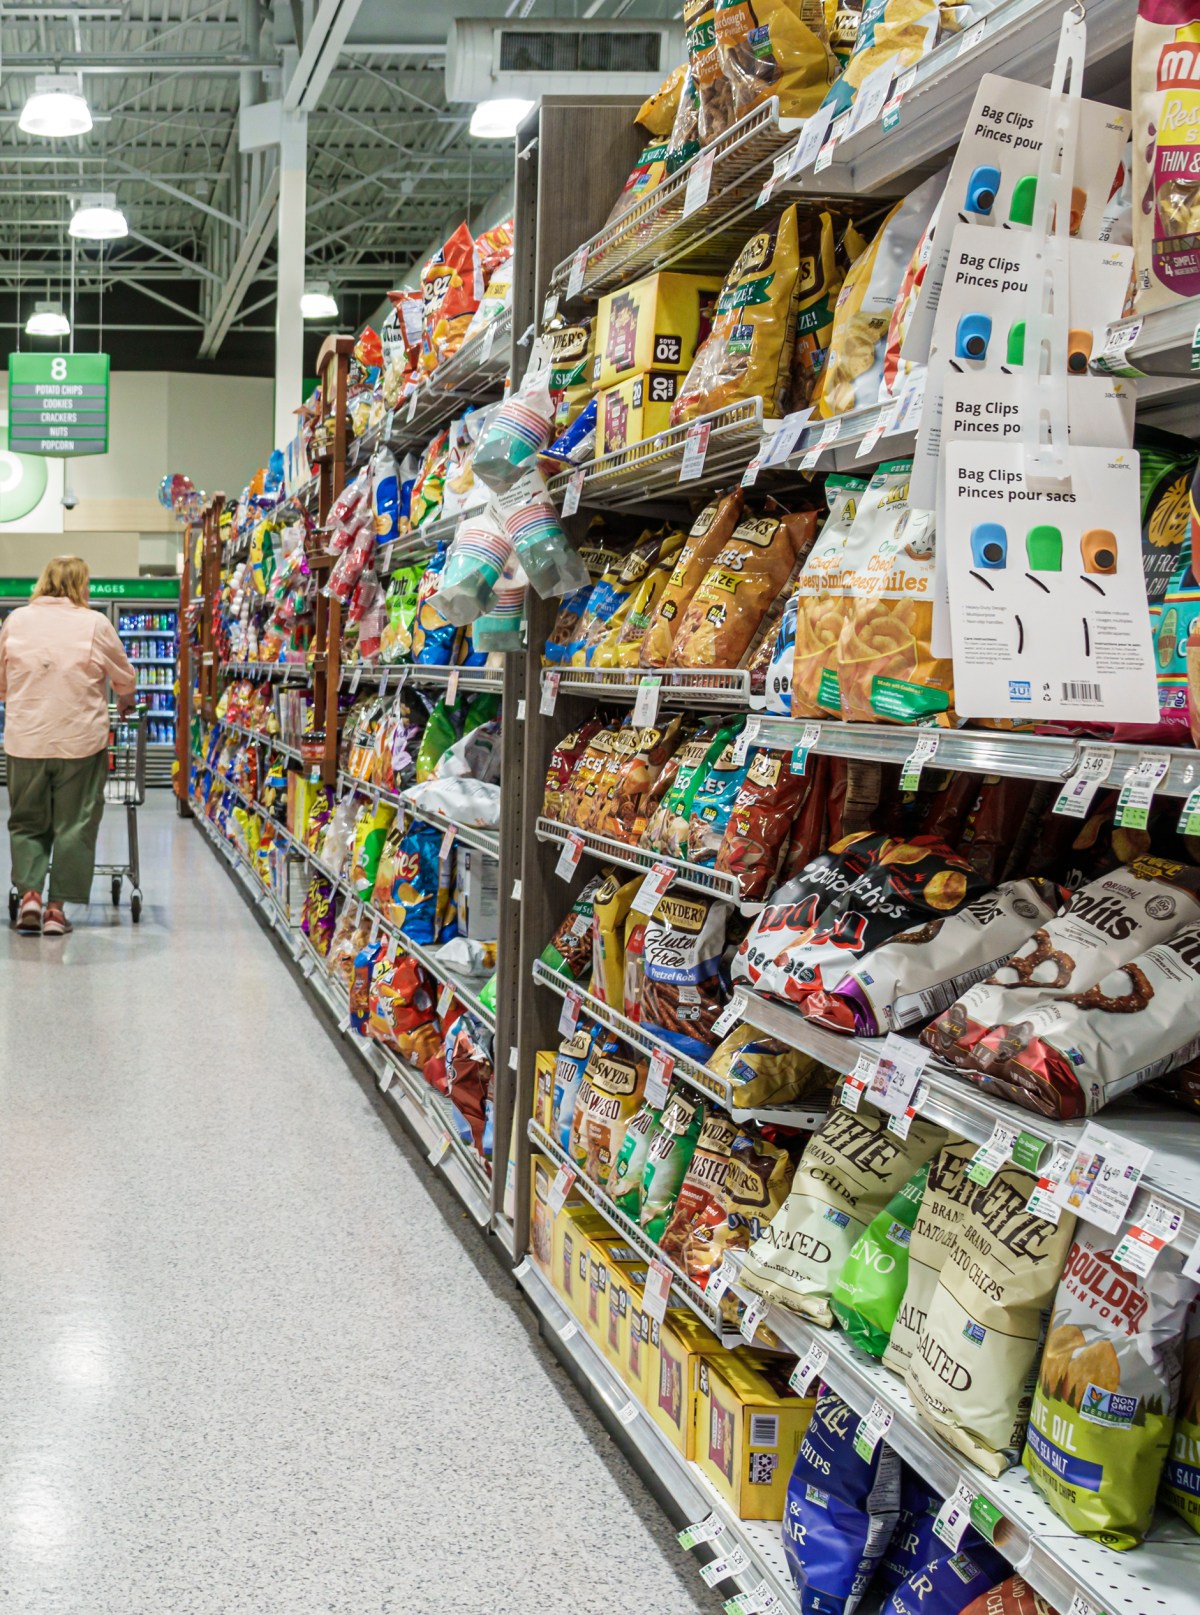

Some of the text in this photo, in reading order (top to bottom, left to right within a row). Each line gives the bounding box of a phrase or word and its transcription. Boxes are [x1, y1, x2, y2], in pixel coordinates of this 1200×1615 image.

[981, 105, 1033, 129] Bag Clips
[975, 124, 1043, 151] Pinces pour
[1161, 152, 1188, 172] THIN
[960, 253, 1020, 272] Bag Clips
[1165, 255, 1196, 275] 4 SIMPLE
[956, 272, 1028, 292] Pinces pou
[51, 358, 67, 381] 8
[35, 385, 83, 395] POTATO CHIPS
[43, 399, 73, 409] COOKIES
[955, 402, 1019, 416] Bag Clips
[41, 413, 77, 422] CRACKERS
[50, 427, 68, 436] NUTS
[954, 420, 1021, 436] Pinces po
[41, 440, 74, 450] POPCORN
[958, 468, 1022, 482] Bag Clips
[958, 486, 1076, 503] Pinces pour sacs
[1157, 554, 1179, 573] FREE
[1084, 758, 1103, 770] 5.49
[1102, 881, 1141, 899] ORIGINAL
[658, 899, 704, 922] SNYDER'S
[758, 893, 820, 933] BBQ
[644, 928, 697, 952] Gluten
[651, 948, 686, 968] Free
[651, 969, 674, 980] Pretzel
[810, 1168, 859, 1206] CHIPS
[964, 1225, 992, 1256] BRAND
[969, 1263, 1005, 1301] CHIPS
[1061, 1242, 1148, 1335] BOULDER
[1066, 1280, 1123, 1327] CANYON
[811, 1346, 822, 1360] 5.29
[872, 1403, 883, 1417] 5.29
[1111, 1402, 1133, 1411] GMO
[1113, 1396, 1134, 1405] NON
[1084, 1406, 1130, 1422] VERIFIED
[1110, 1409, 1132, 1417] Project
[1052, 1415, 1077, 1452] OIL
[801, 1439, 831, 1475] CHIPS
[1041, 1442, 1068, 1474] SEA SALT
[958, 1487, 973, 1502] 4.29
[1060, 1484, 1076, 1503] CHIPS
[790, 1502, 800, 1517] &
